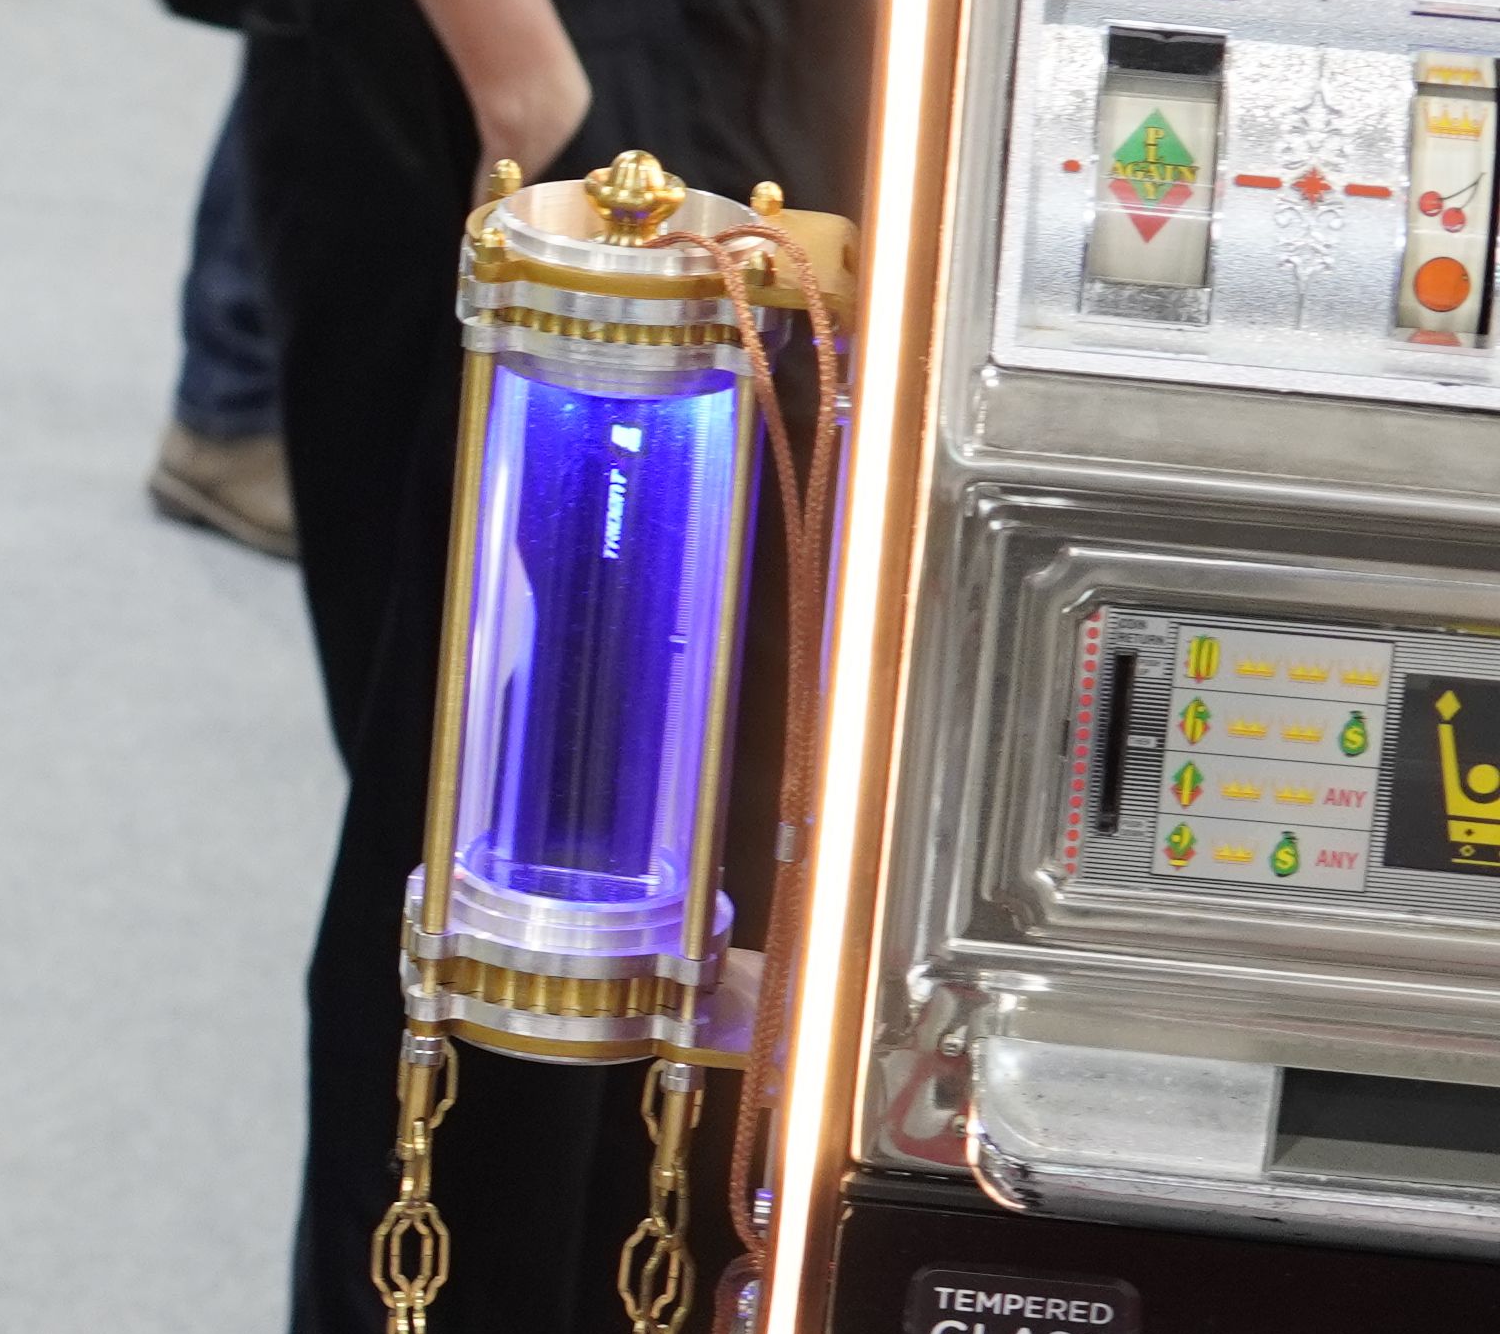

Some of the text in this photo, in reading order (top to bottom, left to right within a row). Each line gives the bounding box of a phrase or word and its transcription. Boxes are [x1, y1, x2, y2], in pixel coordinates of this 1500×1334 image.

[1323, 788, 1368, 809] ANY
[1315, 849, 1360, 870] ANY
[933, 1286, 1115, 1325] TEMPERED
